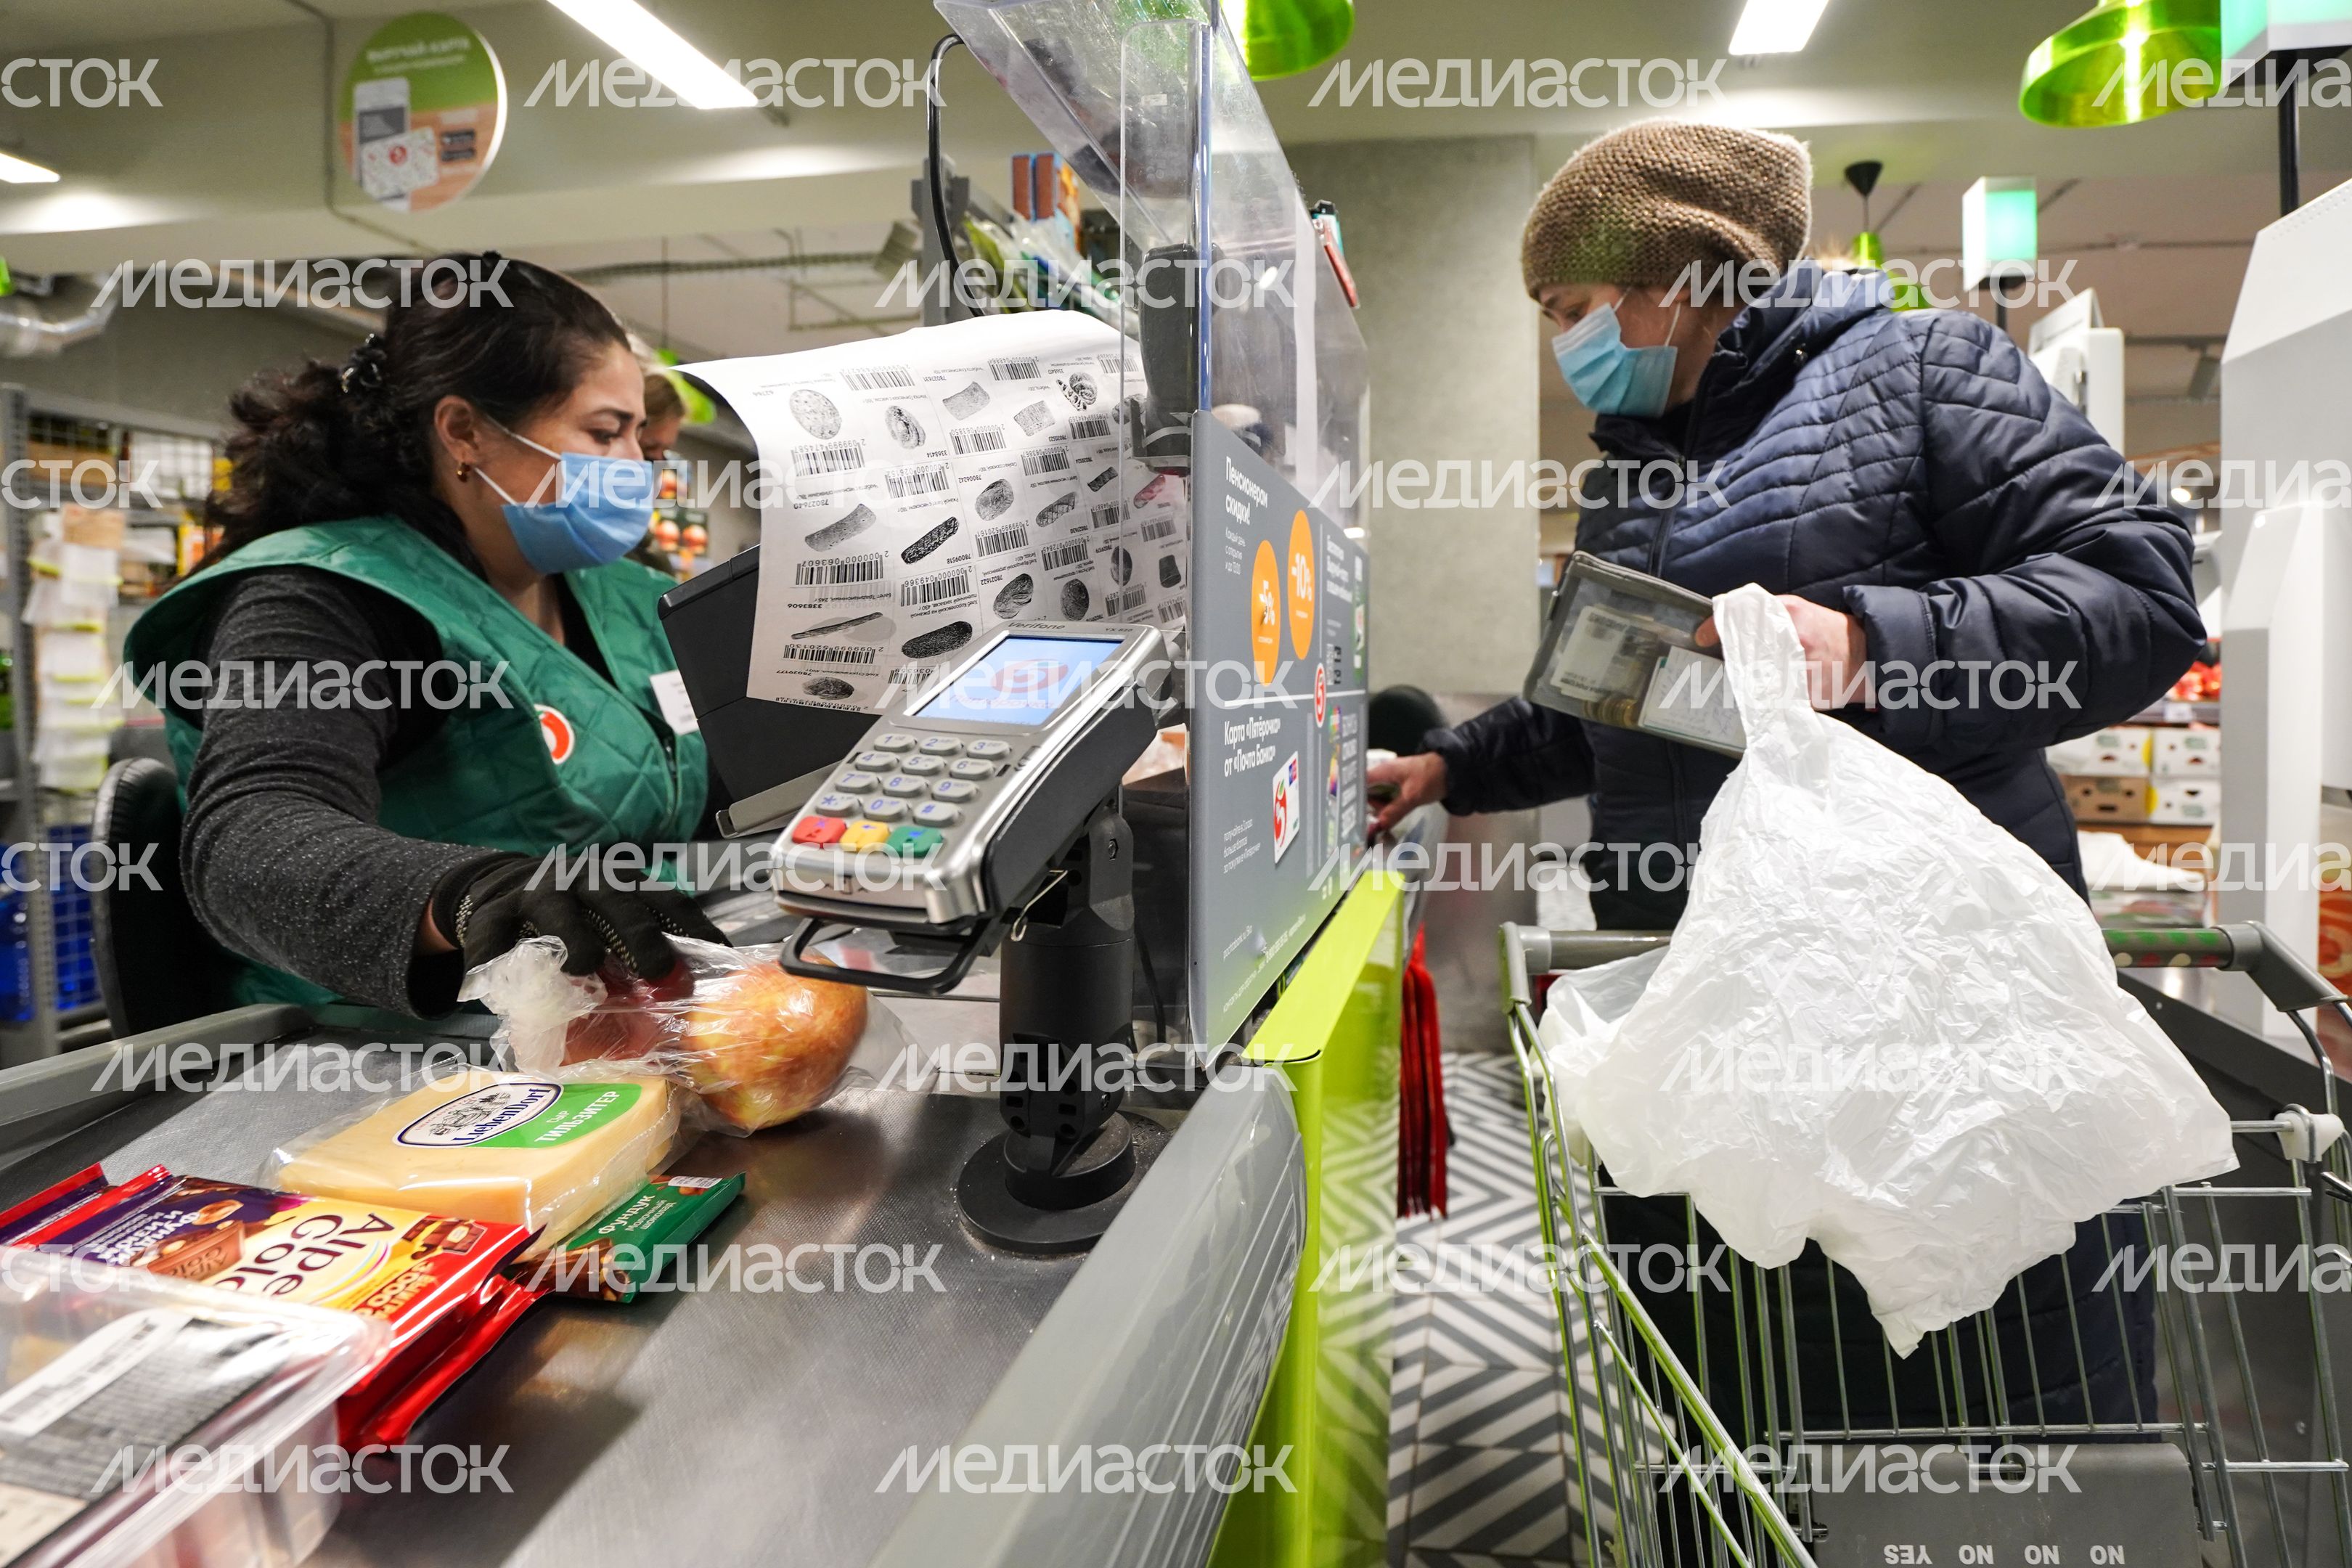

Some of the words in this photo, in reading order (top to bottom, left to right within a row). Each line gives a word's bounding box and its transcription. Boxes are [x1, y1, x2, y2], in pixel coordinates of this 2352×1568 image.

[1226, 456, 1268, 508] Пенсионерам
[1008, 621, 1065, 630] Verifone
[926, 738, 938, 747] 2
[1224, 720, 1245, 750] Карта
[974, 741, 986, 751] 3
[909, 756, 920, 766] 5
[957, 760, 968, 769] 6
[1224, 754, 1232, 777] от
[939, 781, 952, 791] 9
[534, 1090, 621, 1143] ТИЛЬЗИТЕР
[598, 1195, 656, 1234] Фундук
[1883, 1544, 1933, 1565] YES
[1959, 1545, 1995, 1565] NO
[2024, 1545, 2060, 1565] NO
[2086, 1545, 2126, 1565] NO
